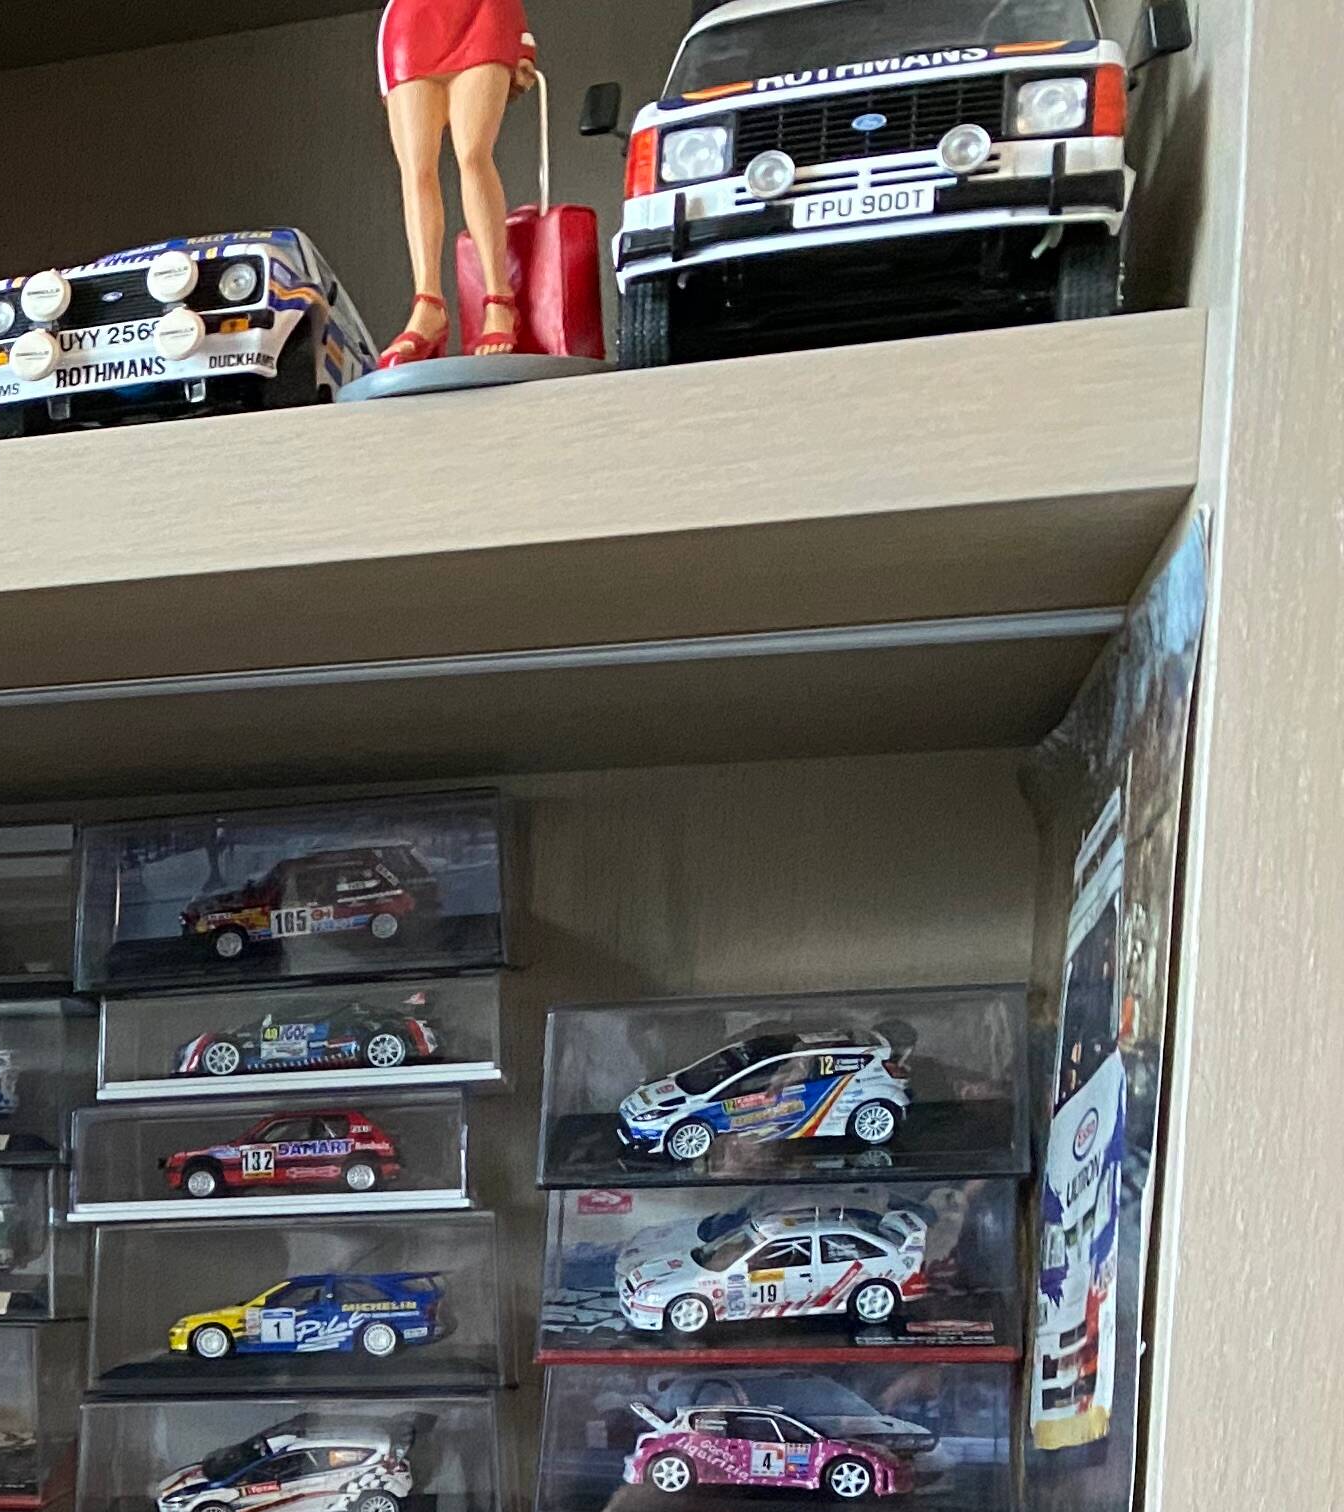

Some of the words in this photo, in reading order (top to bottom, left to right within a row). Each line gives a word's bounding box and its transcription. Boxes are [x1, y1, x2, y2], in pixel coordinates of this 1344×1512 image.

[806, 196, 853, 222] FPU
[861, 189, 926, 217] 900T
[208, 353, 275, 370] DUCKHAMS
[55, 356, 167, 388] ROTHMANS
[817, 1054, 834, 1075] 12
[276, 1138, 354, 1156] DAMART
[241, 1150, 274, 1172] 132
[758, 1283, 777, 1303] 19
[273, 1321, 281, 1340] 1
[762, 1452, 772, 1471] 4
